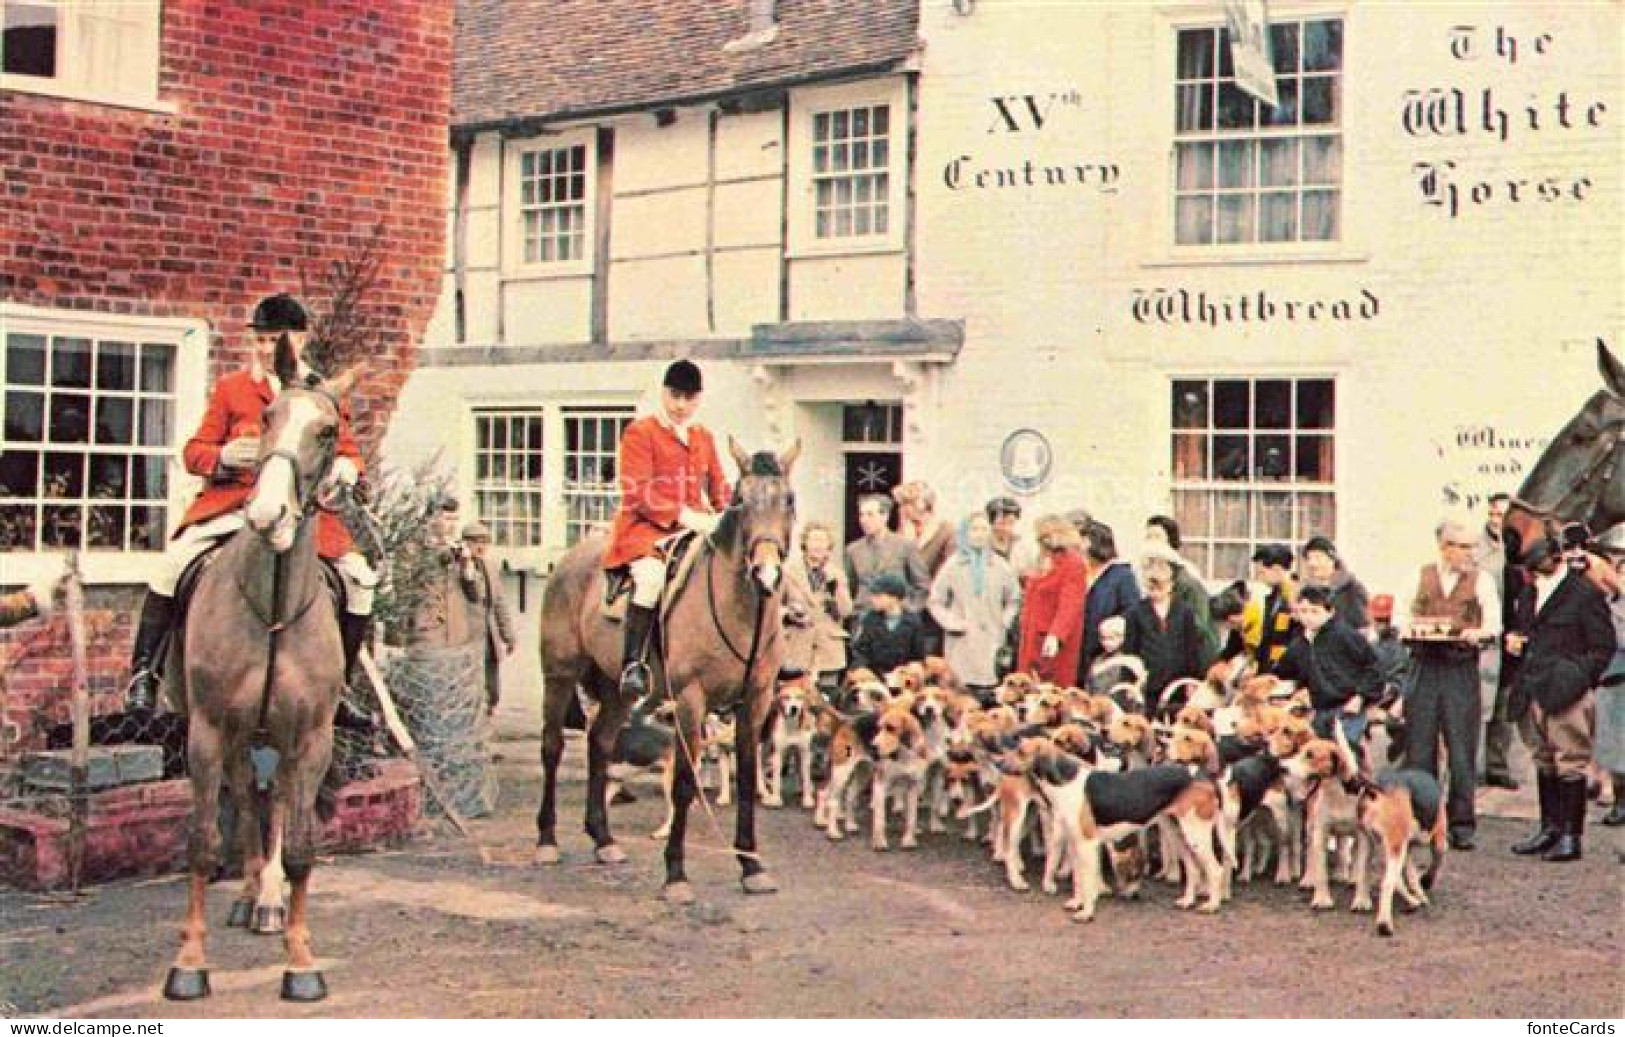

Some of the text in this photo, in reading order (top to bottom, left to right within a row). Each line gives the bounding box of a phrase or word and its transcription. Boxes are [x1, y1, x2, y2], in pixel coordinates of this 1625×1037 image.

[1450, 25, 1554, 65] The
[1401, 87, 1607, 142] White
[942, 154, 1120, 194] Century
[1412, 160, 1593, 218] Horse
[1131, 288, 1380, 328] Whitbread
[1478, 458, 1522, 474] and
